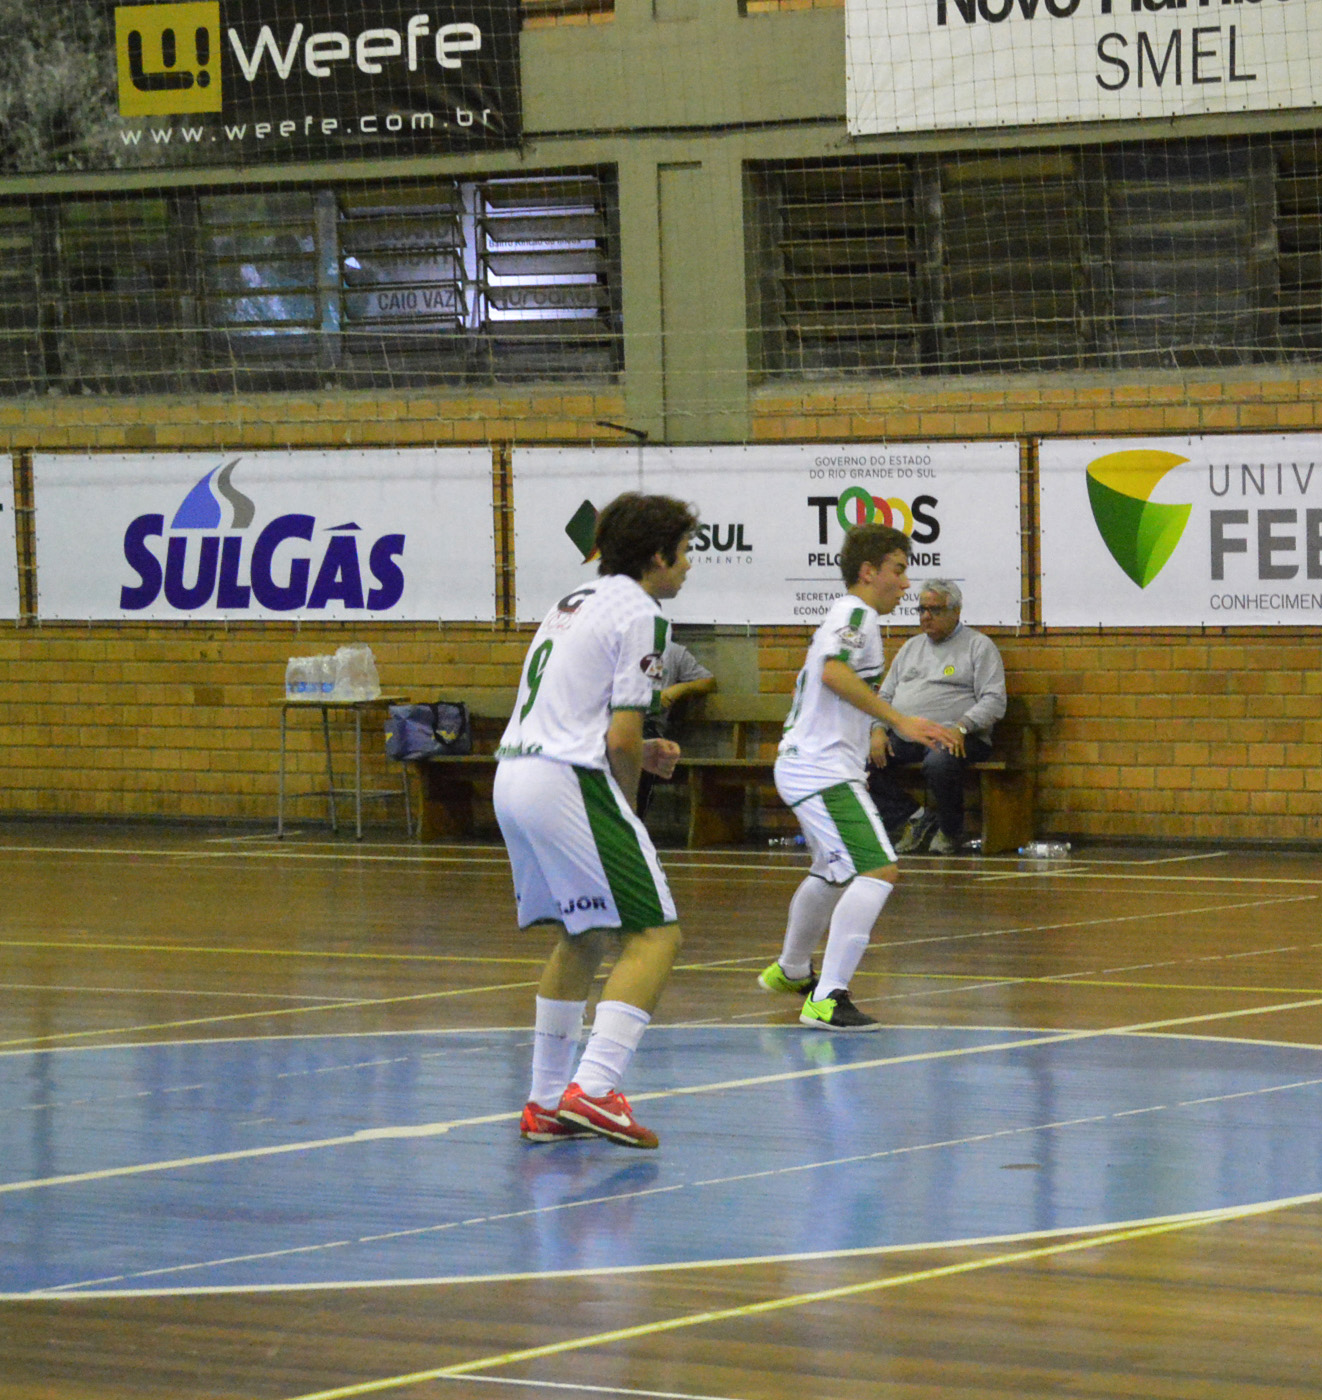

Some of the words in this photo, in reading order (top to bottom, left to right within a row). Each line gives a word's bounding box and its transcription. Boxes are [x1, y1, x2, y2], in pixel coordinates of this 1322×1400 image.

[227, 13, 482, 81] Weefe
[1096, 25, 1257, 91] SMEL
[120, 107, 491, 145] www.weefe.com.br
[377, 291, 418, 311] CAIO
[424, 289, 456, 309] VAZ
[809, 469, 825, 479] DO
[829, 469, 847, 479] RIO
[850, 468, 894, 479] GRANDE
[897, 468, 914, 478] DO
[917, 467, 937, 478] SUL
[815, 456, 867, 467] GOVERNO
[870, 456, 887, 466] DO
[889, 455, 932, 466] ESTADO
[520, 638, 554, 725] 9
